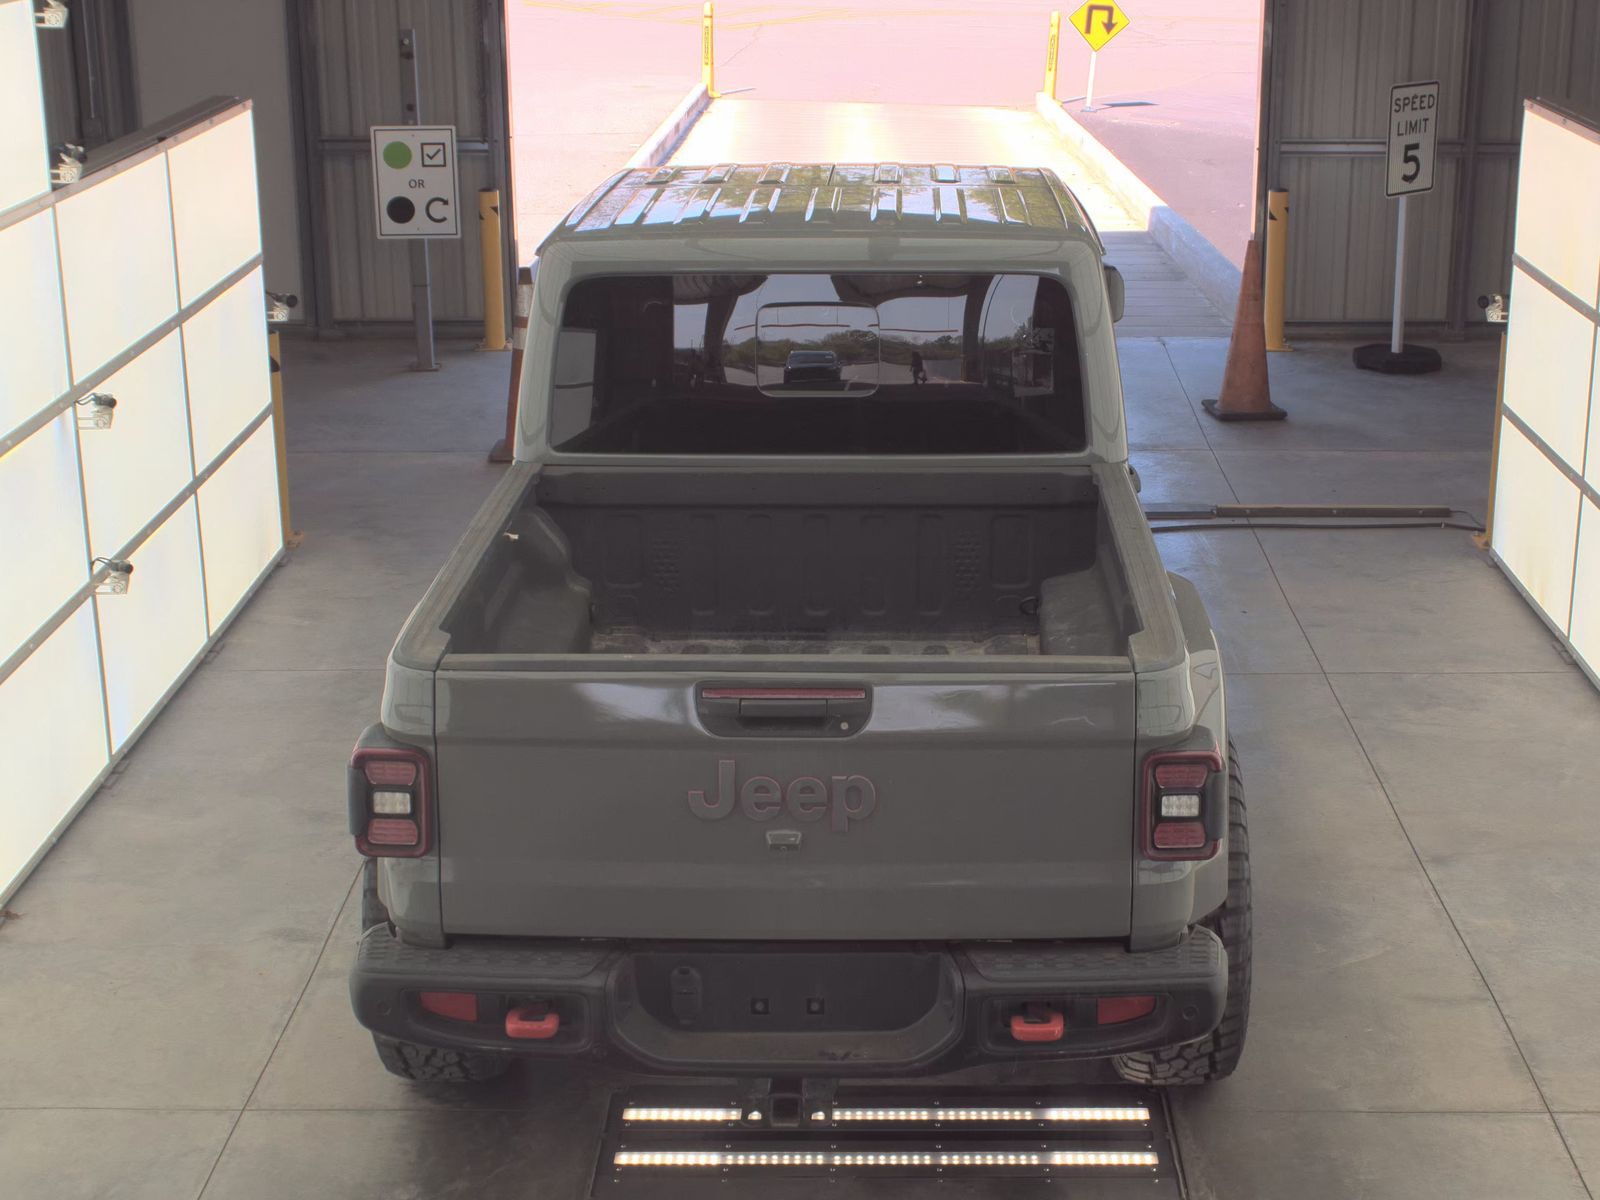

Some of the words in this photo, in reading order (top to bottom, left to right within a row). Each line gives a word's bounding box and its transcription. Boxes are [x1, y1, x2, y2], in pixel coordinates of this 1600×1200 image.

[1394, 94, 1435, 113] SPEED
[1397, 118, 1429, 136] LIMIT
[1401, 143, 1420, 184] 5
[408, 179, 425, 188] OR
[687, 760, 876, 832] Jeep
